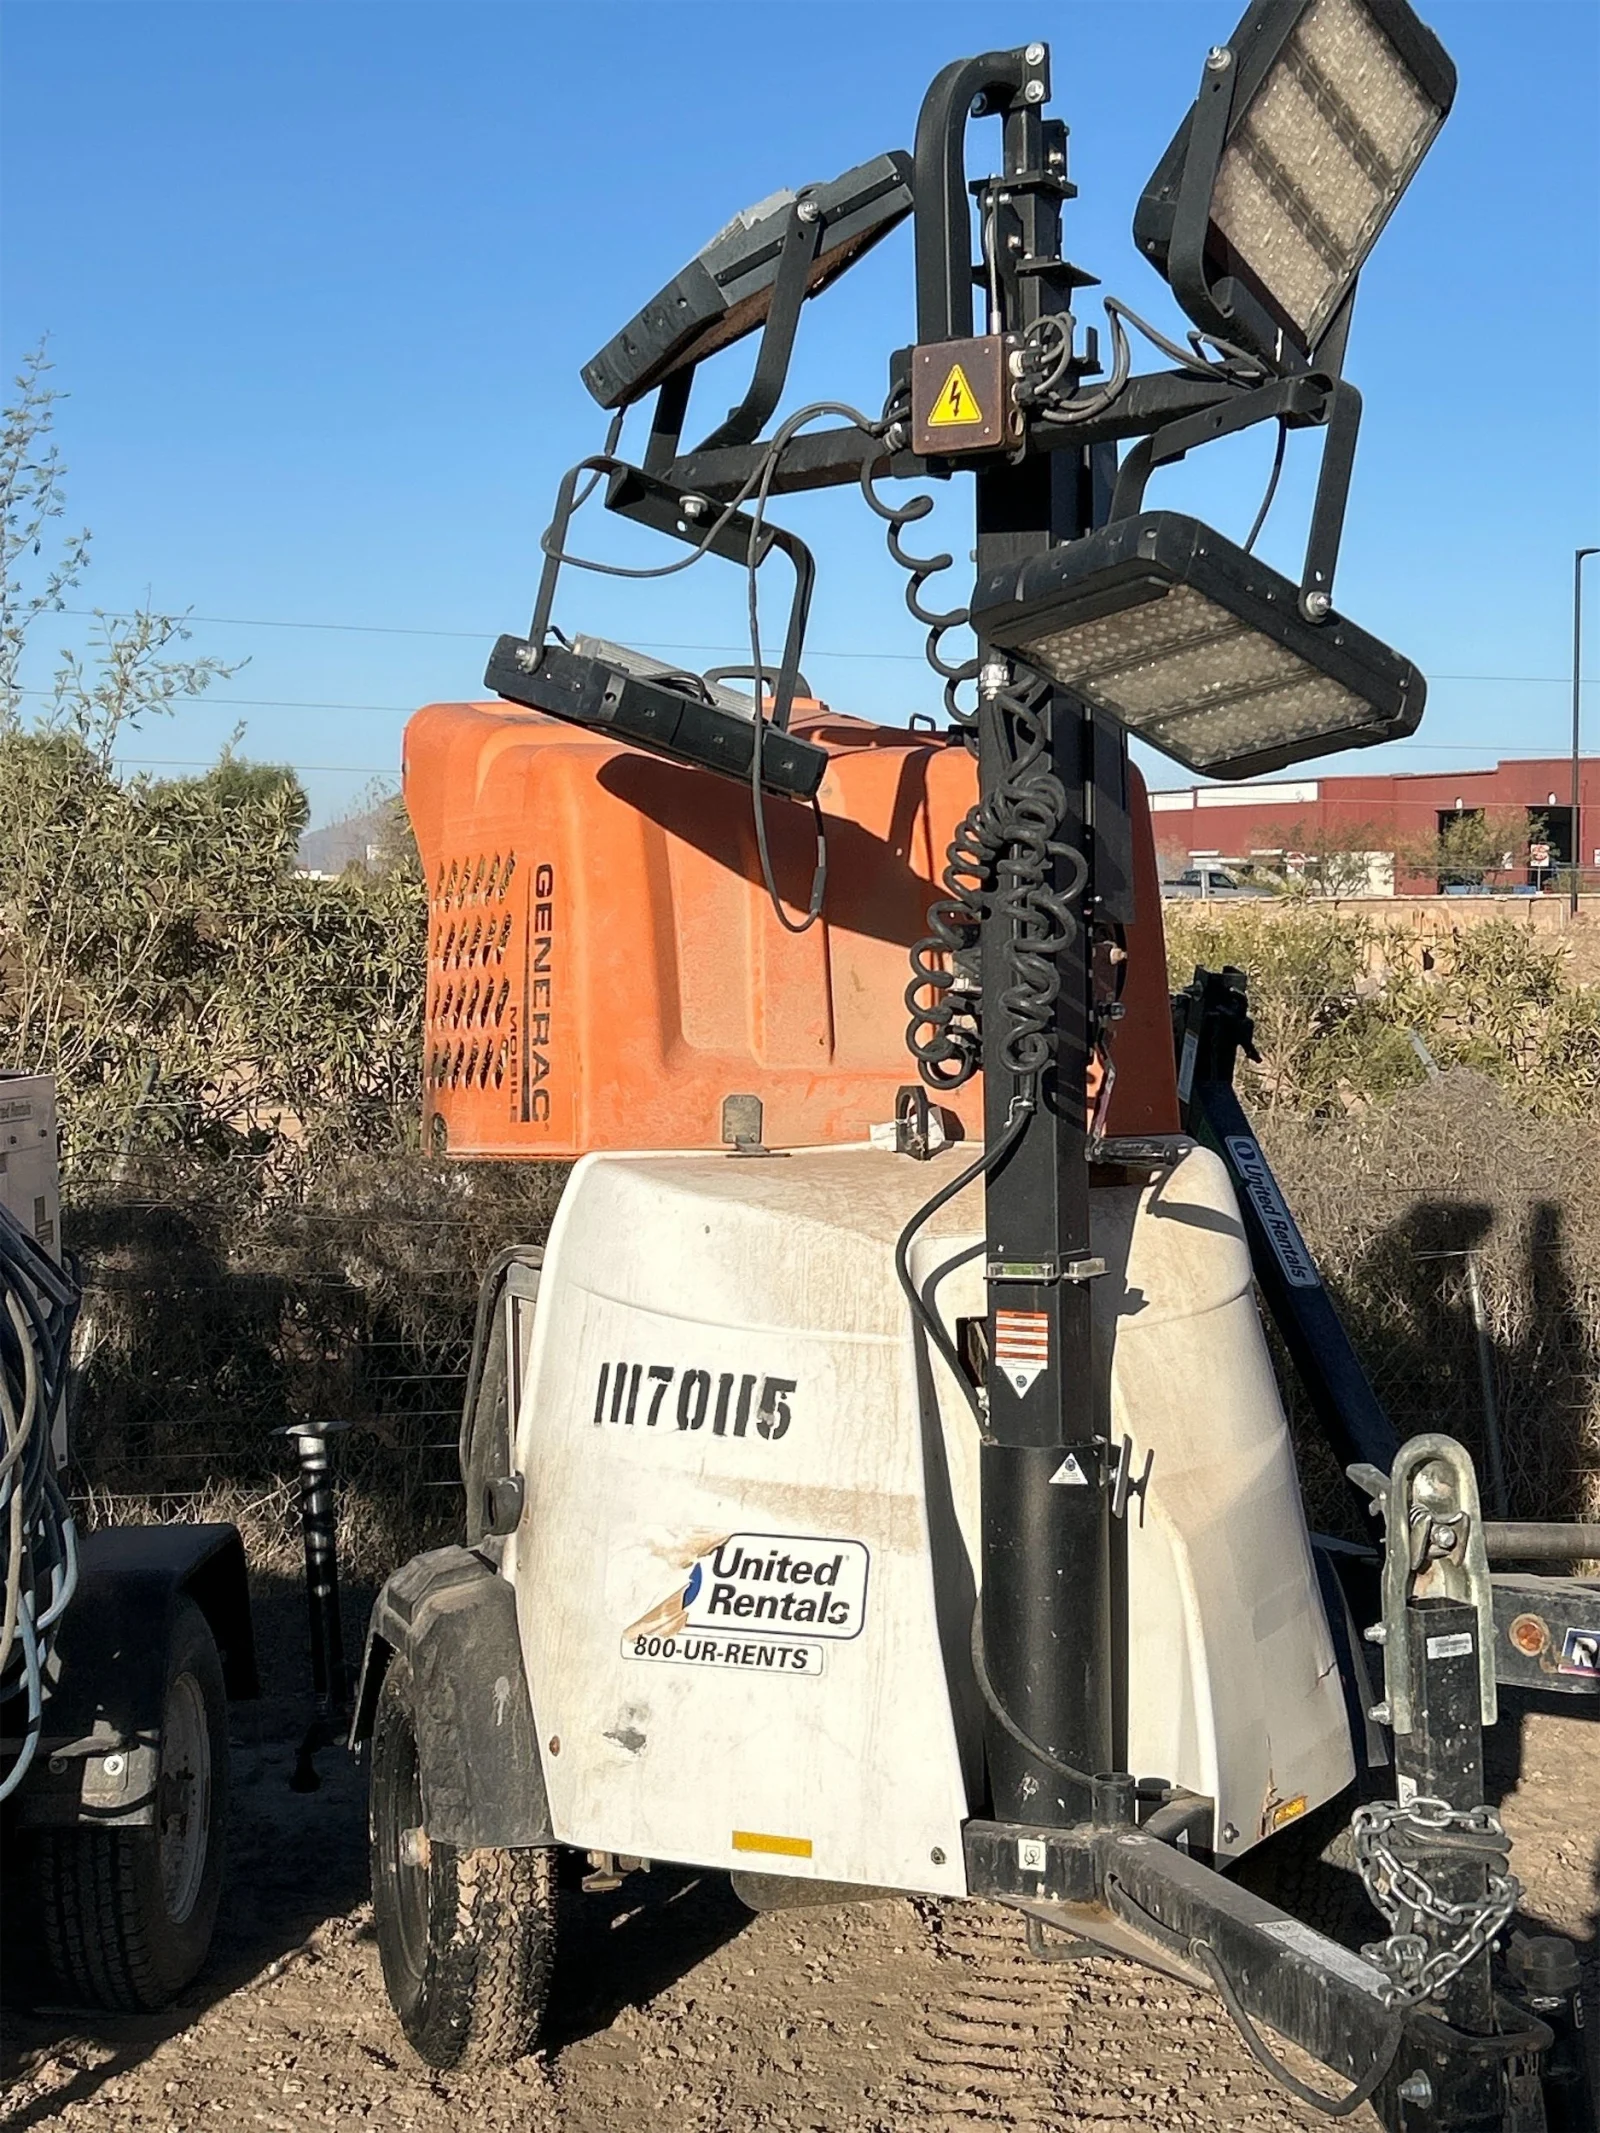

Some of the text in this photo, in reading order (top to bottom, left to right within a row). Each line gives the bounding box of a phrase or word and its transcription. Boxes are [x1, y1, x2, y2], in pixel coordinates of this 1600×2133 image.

[531, 864, 553, 1122] GENERAC
[509, 1006, 518, 1123] MOBILE
[1243, 1165, 1307, 1279] United Rentals
[707, 1583, 850, 1625] Rentals
[712, 1546, 843, 1586] United
[634, 1636, 809, 1669] 800-UR-RENTS
